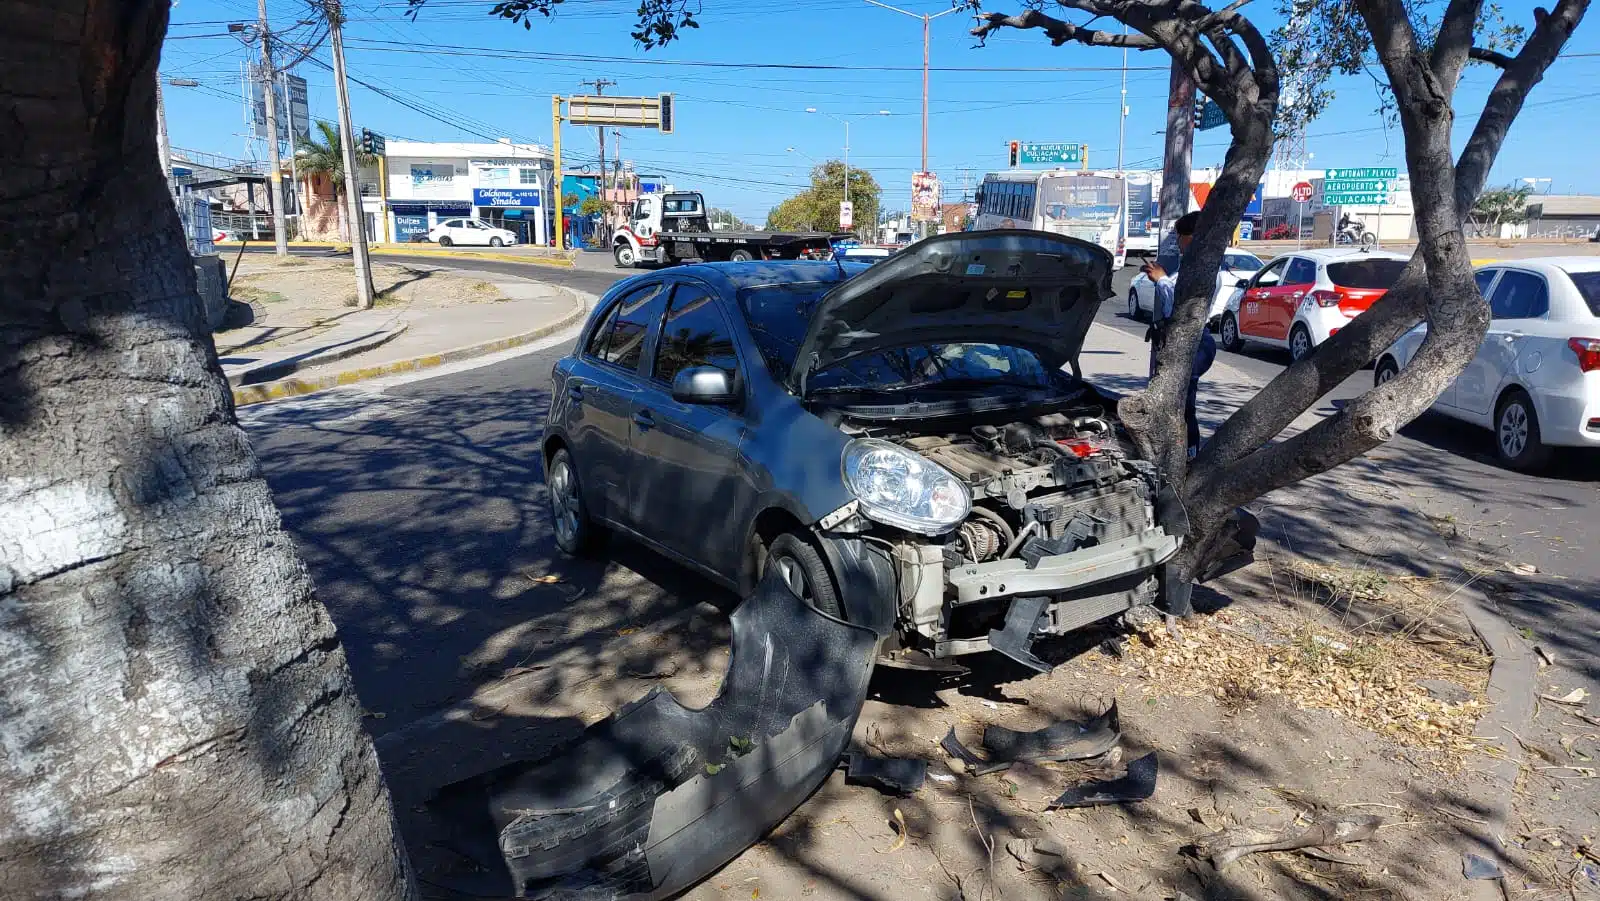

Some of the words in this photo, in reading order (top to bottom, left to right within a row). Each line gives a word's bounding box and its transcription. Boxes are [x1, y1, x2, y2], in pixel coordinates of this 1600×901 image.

[1371, 168, 1396, 177] PLAYAS
[1293, 186, 1312, 196] ALTO
[1327, 182, 1374, 191] AEROPUERTO
[479, 188, 512, 198] Colchones
[490, 195, 521, 206] Sinaloa
[1326, 194, 1373, 204] CULIACAN
[397, 217, 420, 225] Dulces
